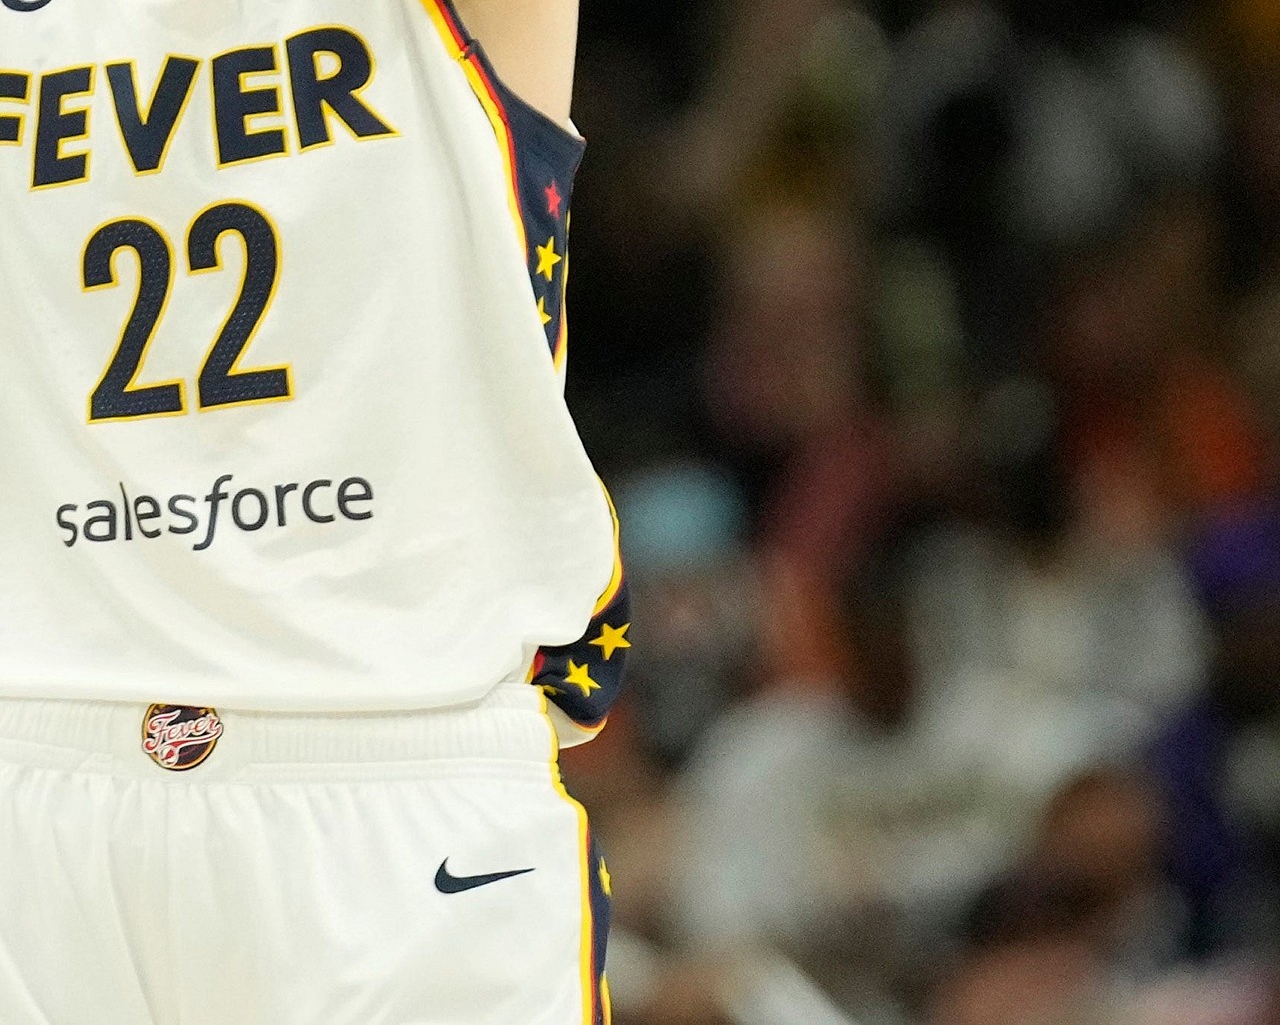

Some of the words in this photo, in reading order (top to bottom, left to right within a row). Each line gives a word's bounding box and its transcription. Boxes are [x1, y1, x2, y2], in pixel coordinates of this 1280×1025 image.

[81, 197, 294, 424] 22
[56, 474, 374, 551] salesforce
[142, 709, 224, 754] Fever
